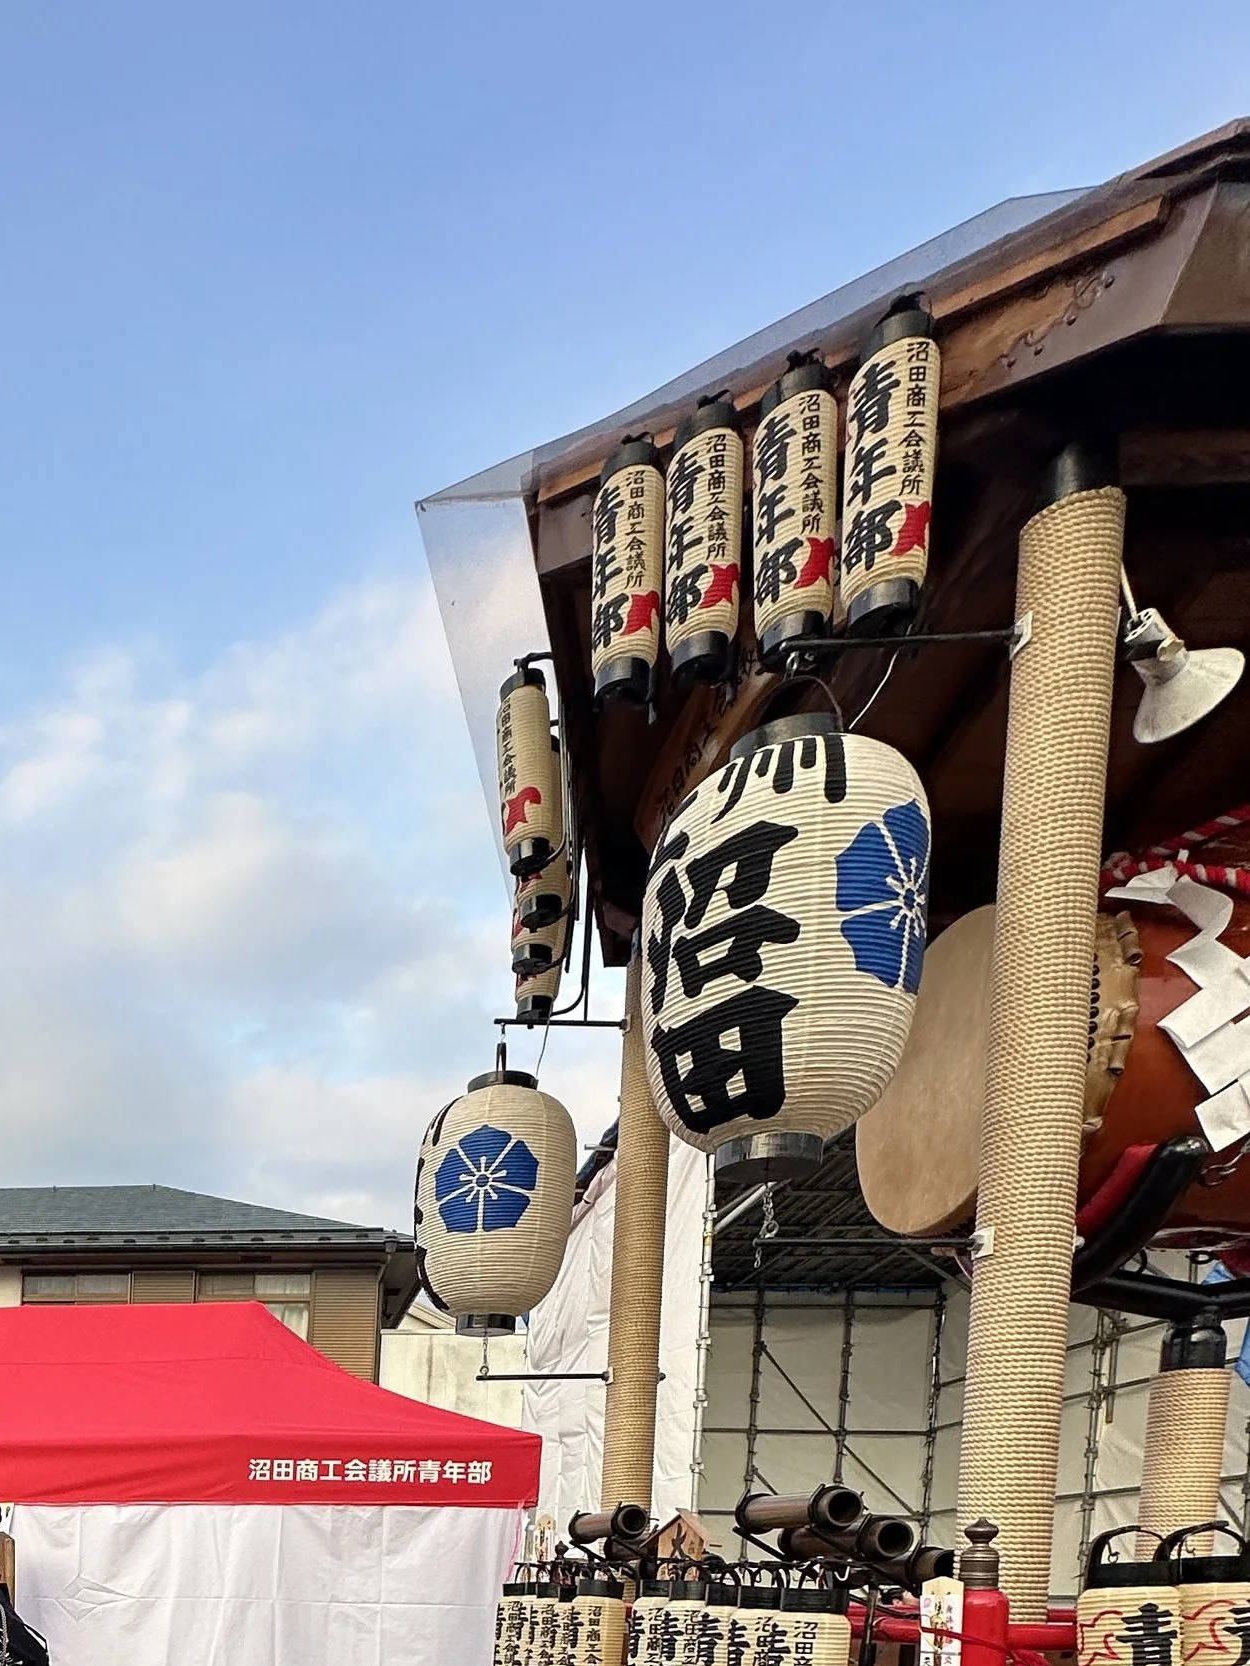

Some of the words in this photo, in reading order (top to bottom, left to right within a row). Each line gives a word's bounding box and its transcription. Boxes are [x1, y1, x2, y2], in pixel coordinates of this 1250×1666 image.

[702, 434, 728, 559] 沼田商工会議所
[798, 394, 825, 535] 沼田商工会議所
[843, 359, 902, 574] 青年部
[898, 341, 931, 497] 沼田商工会議所
[593, 485, 630, 649] 青年部
[623, 470, 646, 589] 沼田商工会議所
[667, 451, 709, 625] 青年部
[754, 412, 803, 604] 青年部
[248, 1457, 493, 1486] 沼田商工会議所青年部
